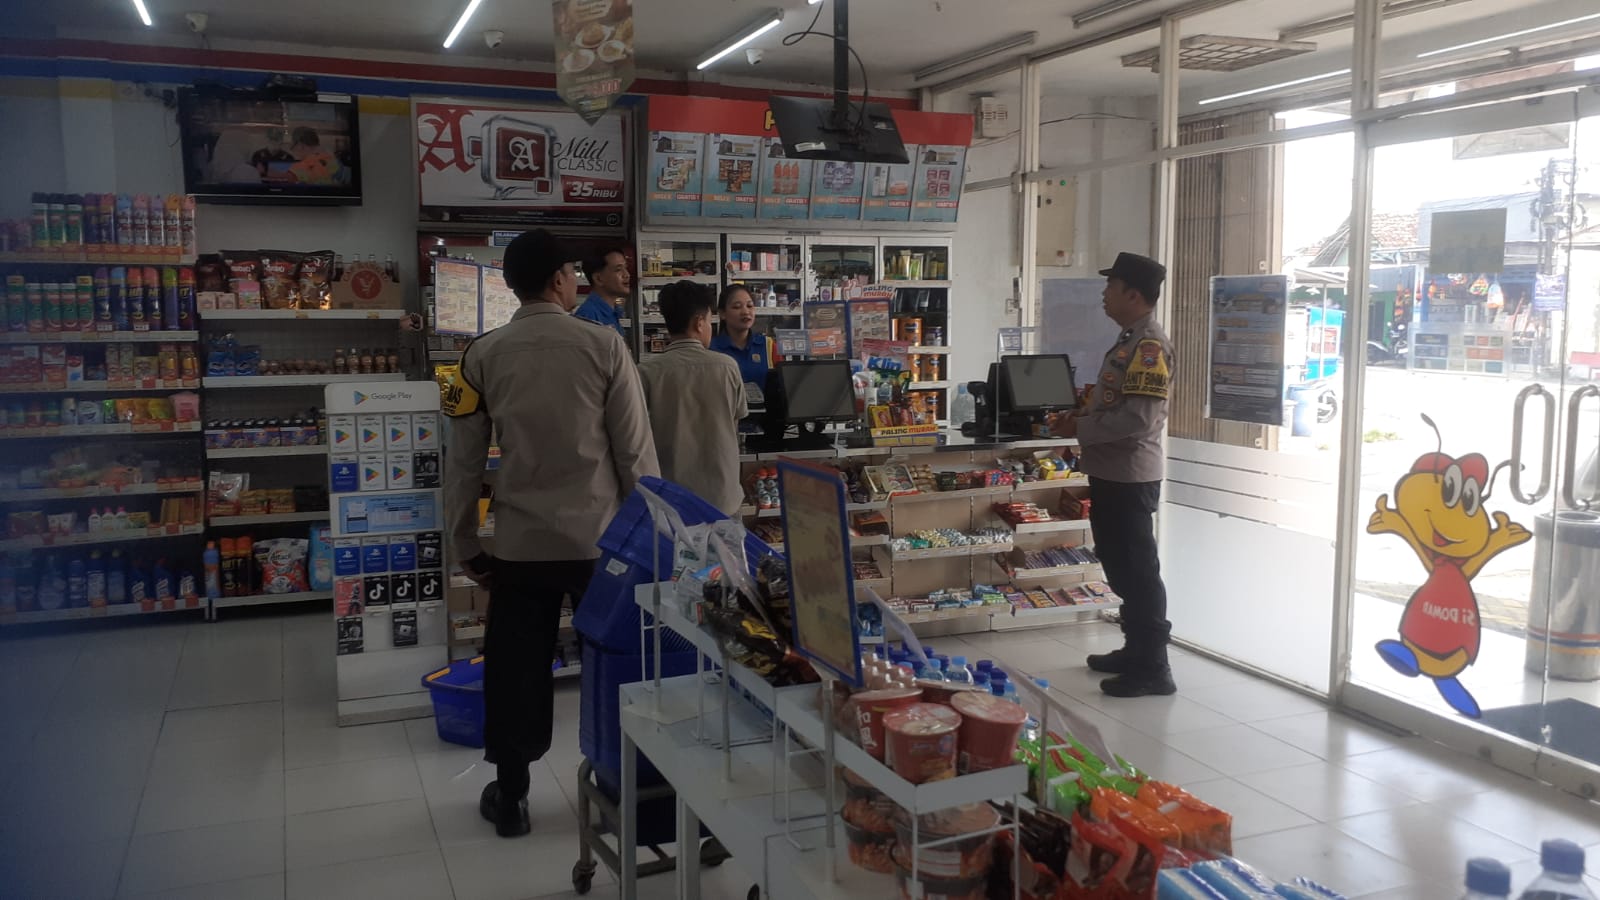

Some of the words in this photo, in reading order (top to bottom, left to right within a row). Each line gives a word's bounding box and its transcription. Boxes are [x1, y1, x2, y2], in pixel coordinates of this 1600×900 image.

[552, 136, 609, 159] Mild
[557, 157, 618, 172] CLASSIC
[569, 181, 594, 197] 35
[592, 189, 620, 198] RIBU
[868, 357, 902, 371] Klin
[370, 392, 396, 401] Google
[397, 391, 413, 400] Play
